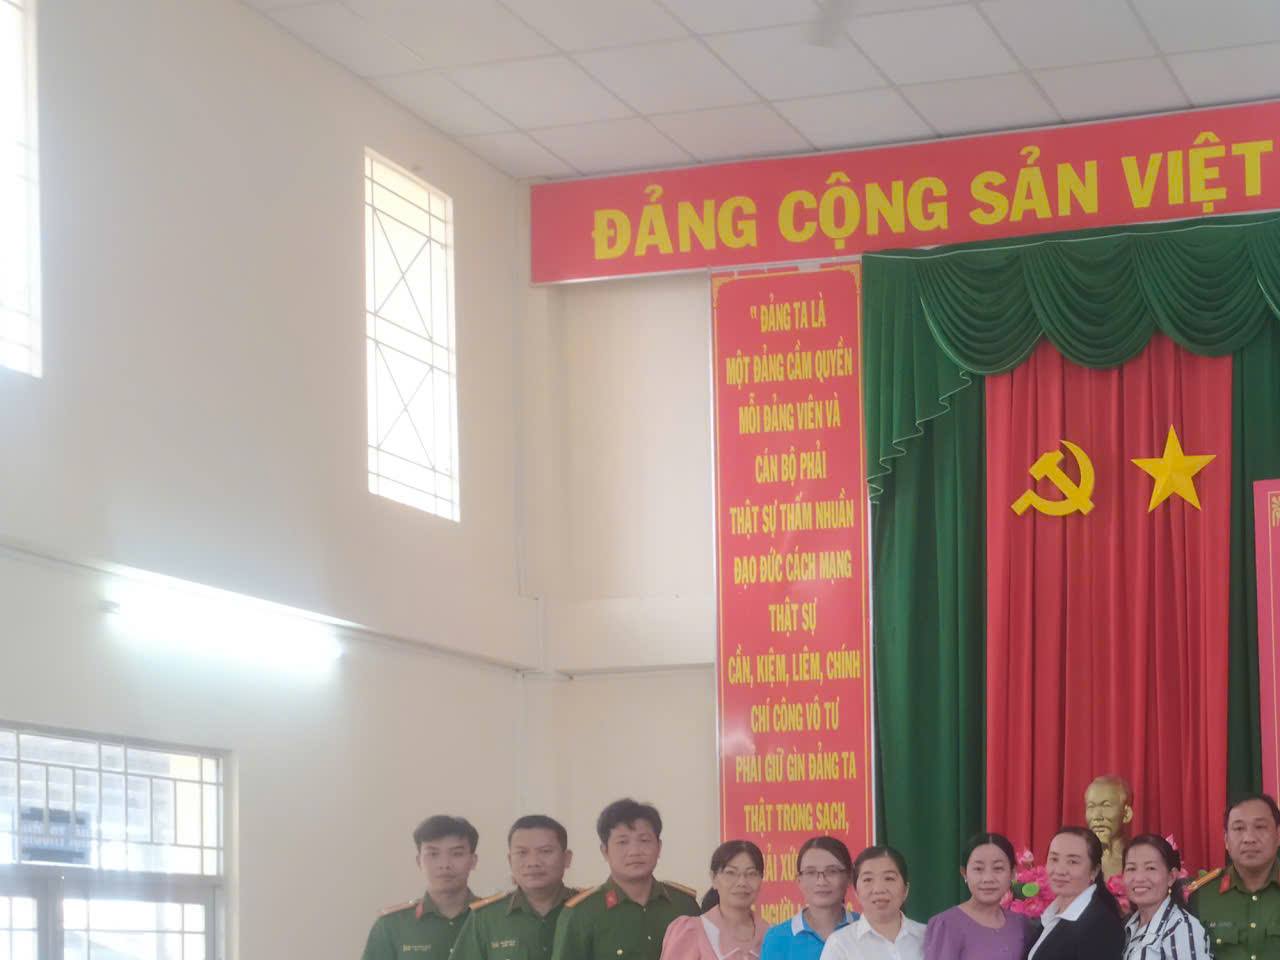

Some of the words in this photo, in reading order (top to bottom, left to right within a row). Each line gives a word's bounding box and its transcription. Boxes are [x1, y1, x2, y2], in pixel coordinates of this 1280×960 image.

[592, 184, 758, 260] ĐẢNG
[778, 171, 948, 249] CỘNG
[970, 145, 1099, 225] SẢN
[1120, 131, 1273, 213] VIỆT
[760, 293, 791, 333] ĐẢNG
[793, 302, 808, 329] TA
[811, 292, 826, 328] LÀ
[726, 350, 751, 390] MỘT
[753, 345, 785, 384] ĐẢNG
[787, 340, 812, 381] CẦM
[815, 336, 853, 384] QUYỀN
[739, 393, 760, 434] MỖI
[764, 393, 794, 433] ĐẢNG
[797, 396, 823, 431] VIÊN
[826, 391, 841, 427] VÀ
[755, 448, 778, 483] CÁN
[781, 446, 797, 486] BỘ
[800, 440, 827, 480] PHẢI
[729, 499, 759, 540] THẬT
[762, 499, 777, 538] SỰ
[780, 492, 812, 532] THẤM
[816, 488, 854, 529] NHUẦN
[734, 556, 757, 590] ĐẠO
[759, 548, 783, 582] ĐỨC
[786, 547, 816, 582] CÁCH
[820, 550, 852, 585] MẠNG
[769, 596, 799, 637] THẬT
[802, 598, 817, 637] SỰ
[826, 644, 861, 681] CHÍNH
[751, 697, 770, 734] CHÍ
[773, 697, 804, 733] CÔNG
[806, 695, 821, 731] VÔ
[824, 697, 840, 730] TƯ
[787, 748, 805, 782] GÌN
[808, 742, 839, 780] ĐẢNG
[841, 751, 857, 780] TA
[744, 797, 773, 837] THẬT
[776, 803, 814, 832] TRONG
